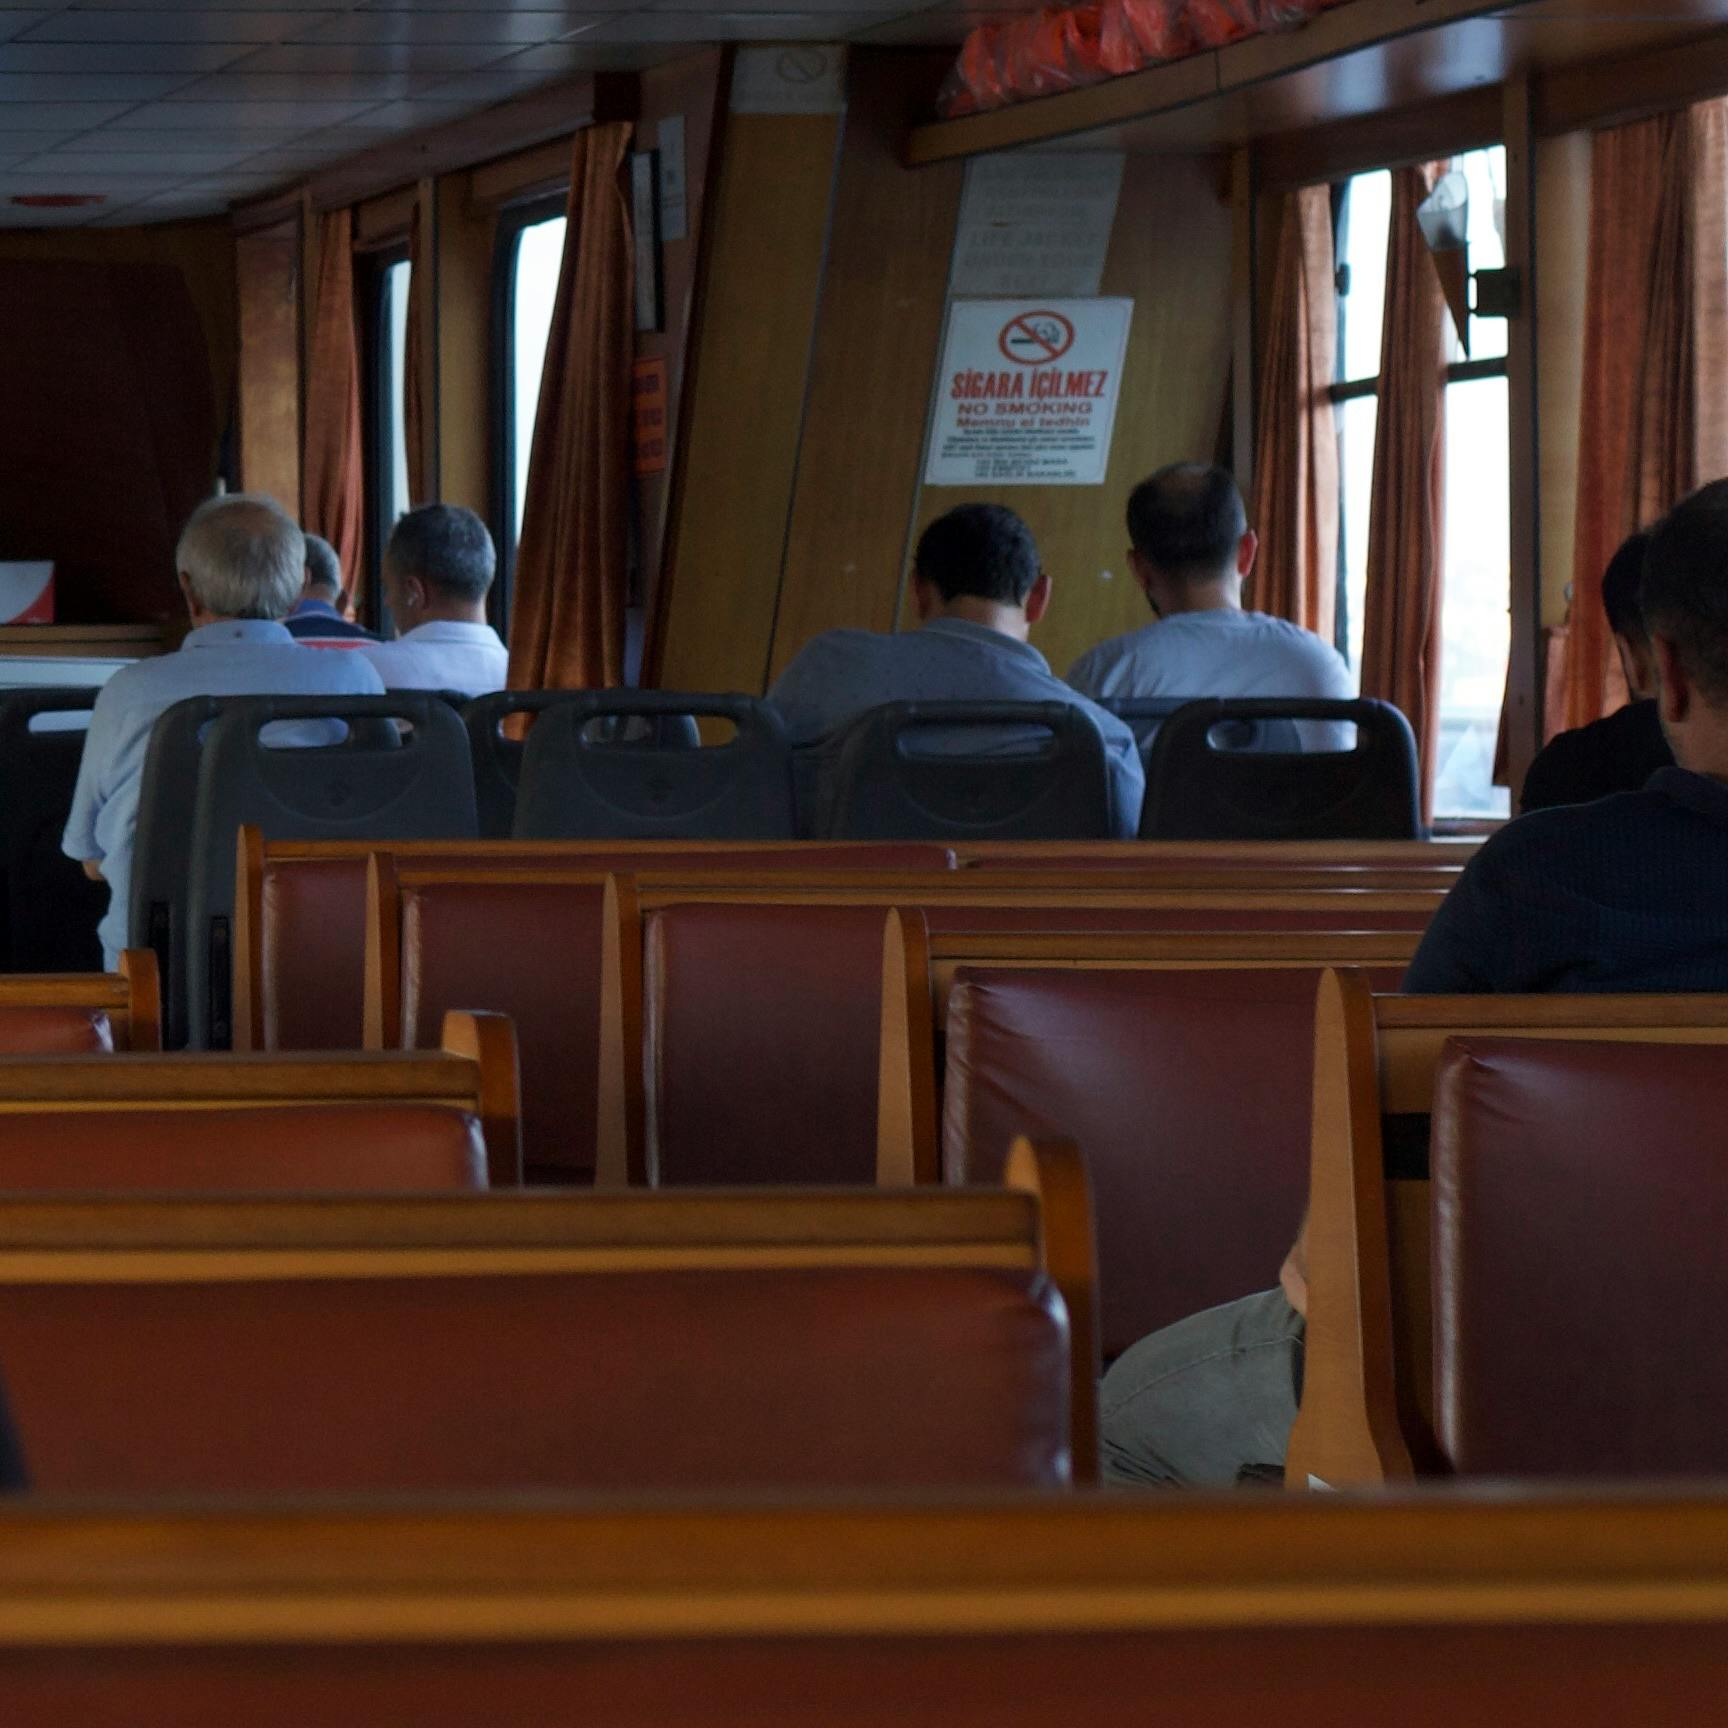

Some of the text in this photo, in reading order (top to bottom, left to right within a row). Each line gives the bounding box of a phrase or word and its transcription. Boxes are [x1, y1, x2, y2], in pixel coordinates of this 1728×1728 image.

[951, 366, 1109, 401] SİGARA İÇİLMEZ
[957, 401, 1093, 415] NO SMOKING
